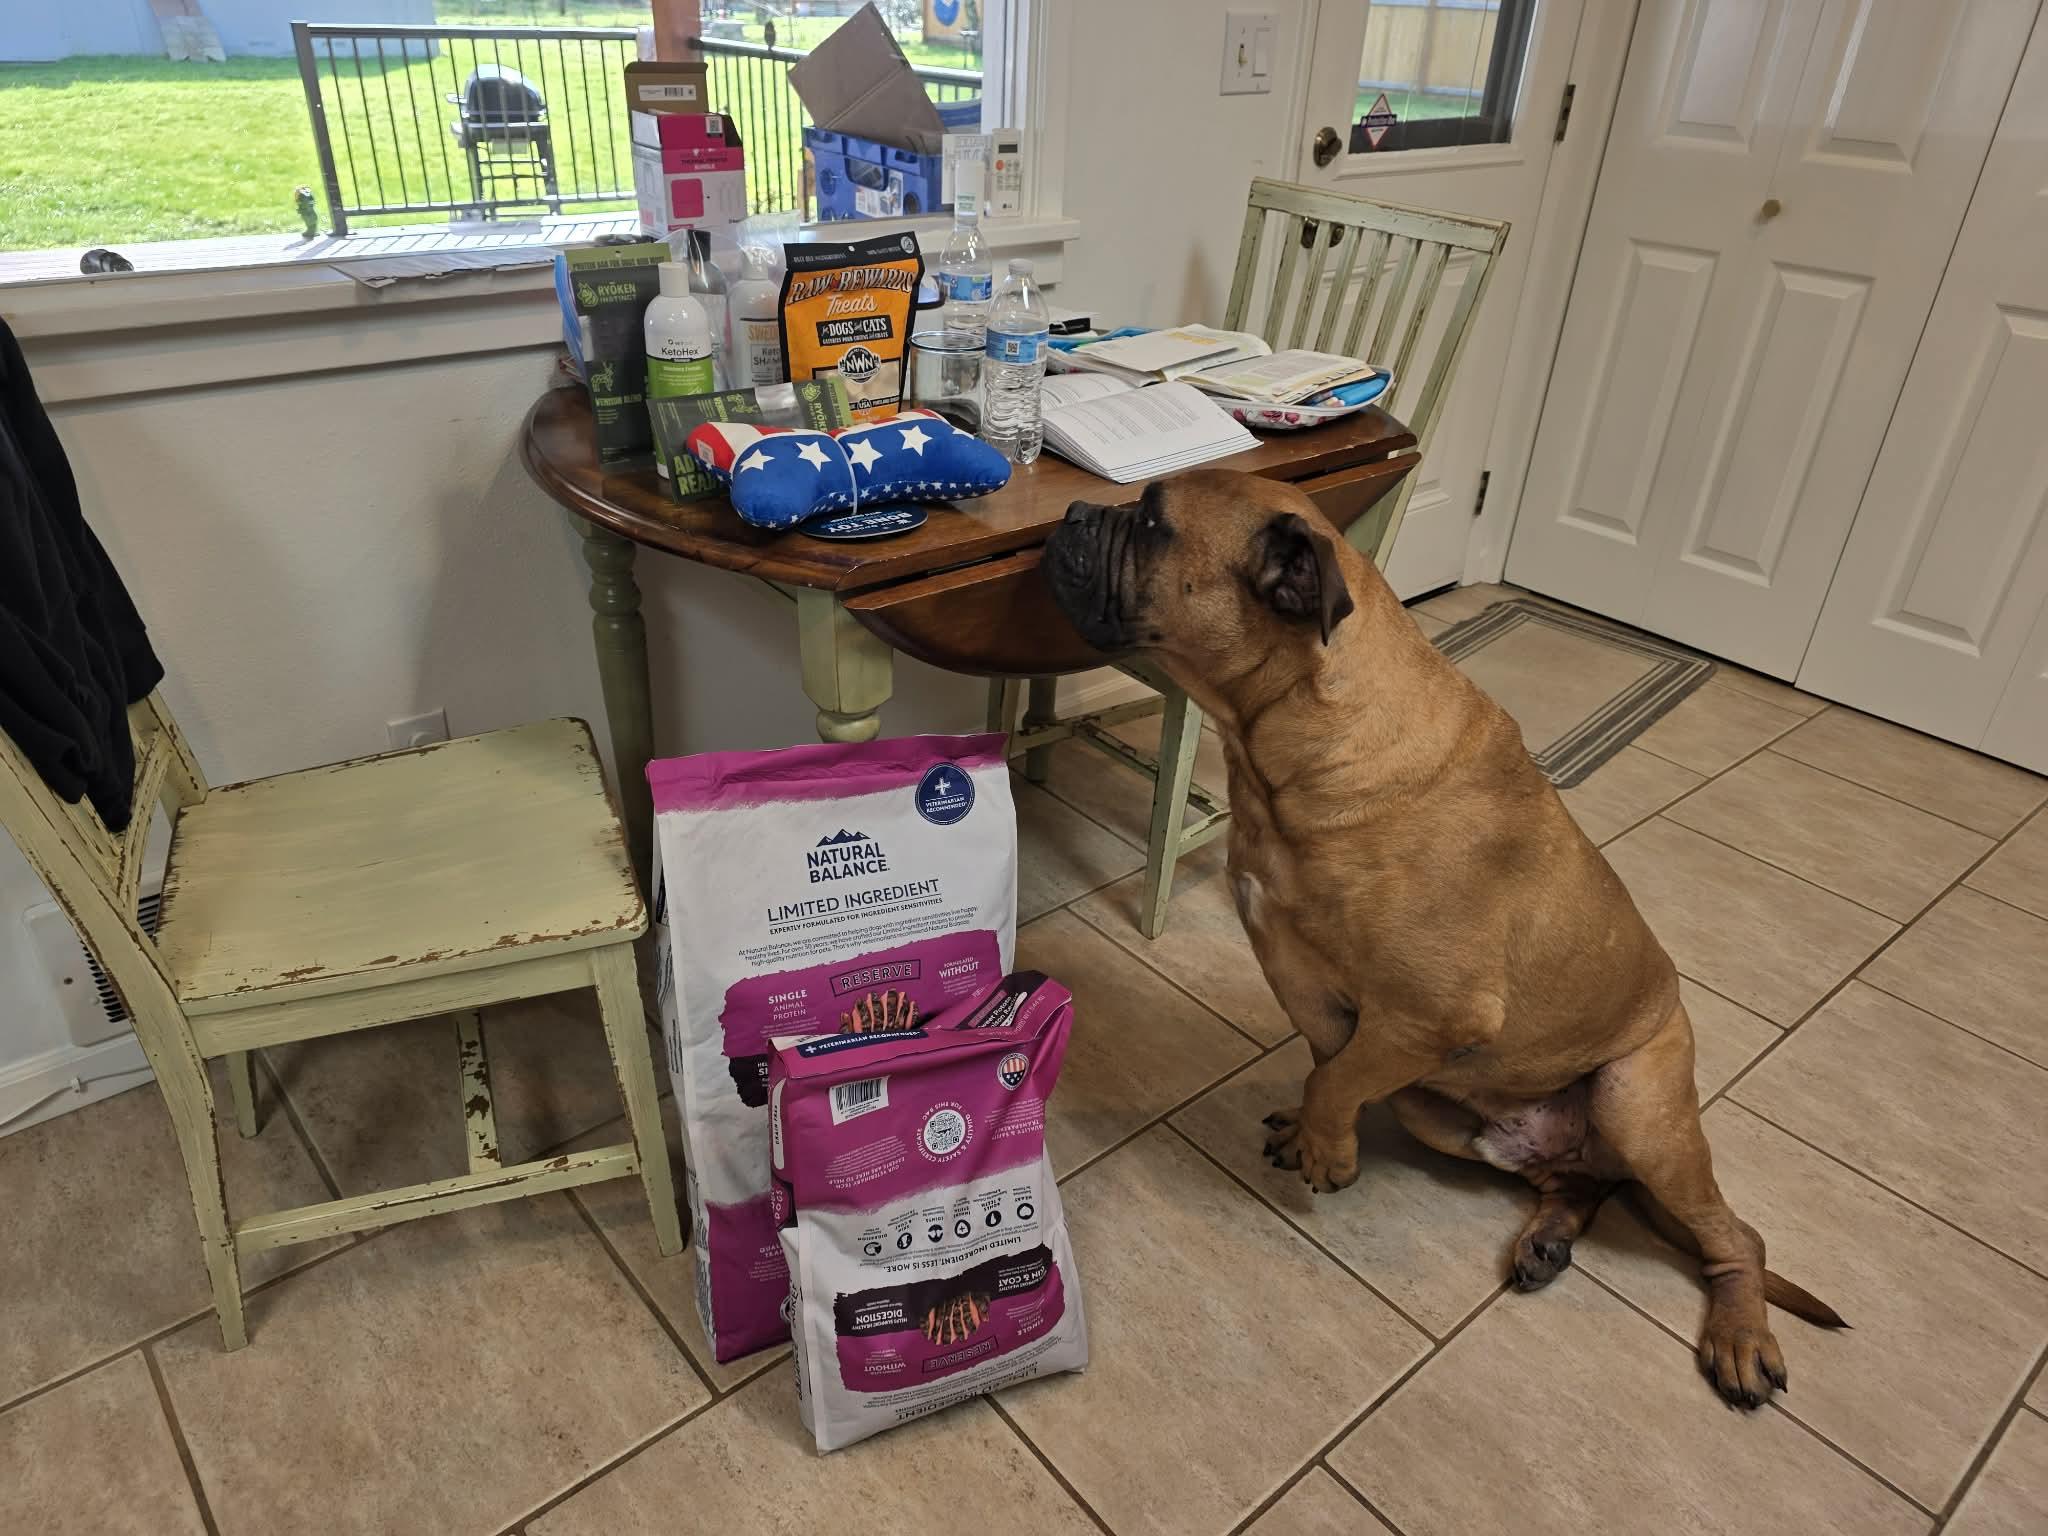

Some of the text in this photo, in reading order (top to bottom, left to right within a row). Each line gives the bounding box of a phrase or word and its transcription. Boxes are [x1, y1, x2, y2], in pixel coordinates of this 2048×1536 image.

[787, 268, 914, 305] RAW REWARDS
[827, 294, 877, 318] Treats
[829, 321, 854, 337] DOGS
[863, 317, 887, 332] CATS
[661, 347, 698, 356] KetoHex
[846, 353, 873, 373] NWN
[925, 796, 965, 807] VETERINARIAN
[807, 842, 886, 868] NATURAL
[767, 878, 940, 922] LIMITED INGREDIENT
[769, 897, 943, 935] EXPERTLY FORMULATED FOR INGREDIENT SENSITIVITIES
[746, 946, 769, 954] Natural
[848, 927, 869, 937] helping
[869, 924, 882, 933] dogs
[895, 917, 921, 928] ingredient
[882, 926, 902, 935] Limited
[928, 923, 949, 933] Natural
[840, 963, 913, 990] RESERVE
[938, 961, 980, 978] WITHOUT
[768, 990, 808, 1004] SINGLE
[773, 1001, 805, 1012] ANIMAL
[773, 1008, 807, 1021] PROTEIN
[818, 1035, 868, 1050] VETERINARIAN
[964, 1113, 974, 1144] QUALITY
[916, 1128, 937, 1163] CERTIFICATE
[938, 1150, 961, 1163] SAFETY
[774, 1189, 784, 1220] DOGS
[760, 1243, 780, 1253] QUAL
[989, 1236, 1022, 1249] LIMITED
[922, 1260, 939, 1269] LESS
[998, 1276, 1022, 1288] COAT
[1023, 1273, 1030, 1281] &
[856, 1309, 903, 1325] DIGESTION
[929, 1341, 992, 1369] RESERVE
[864, 1362, 907, 1372] WITHOUT
